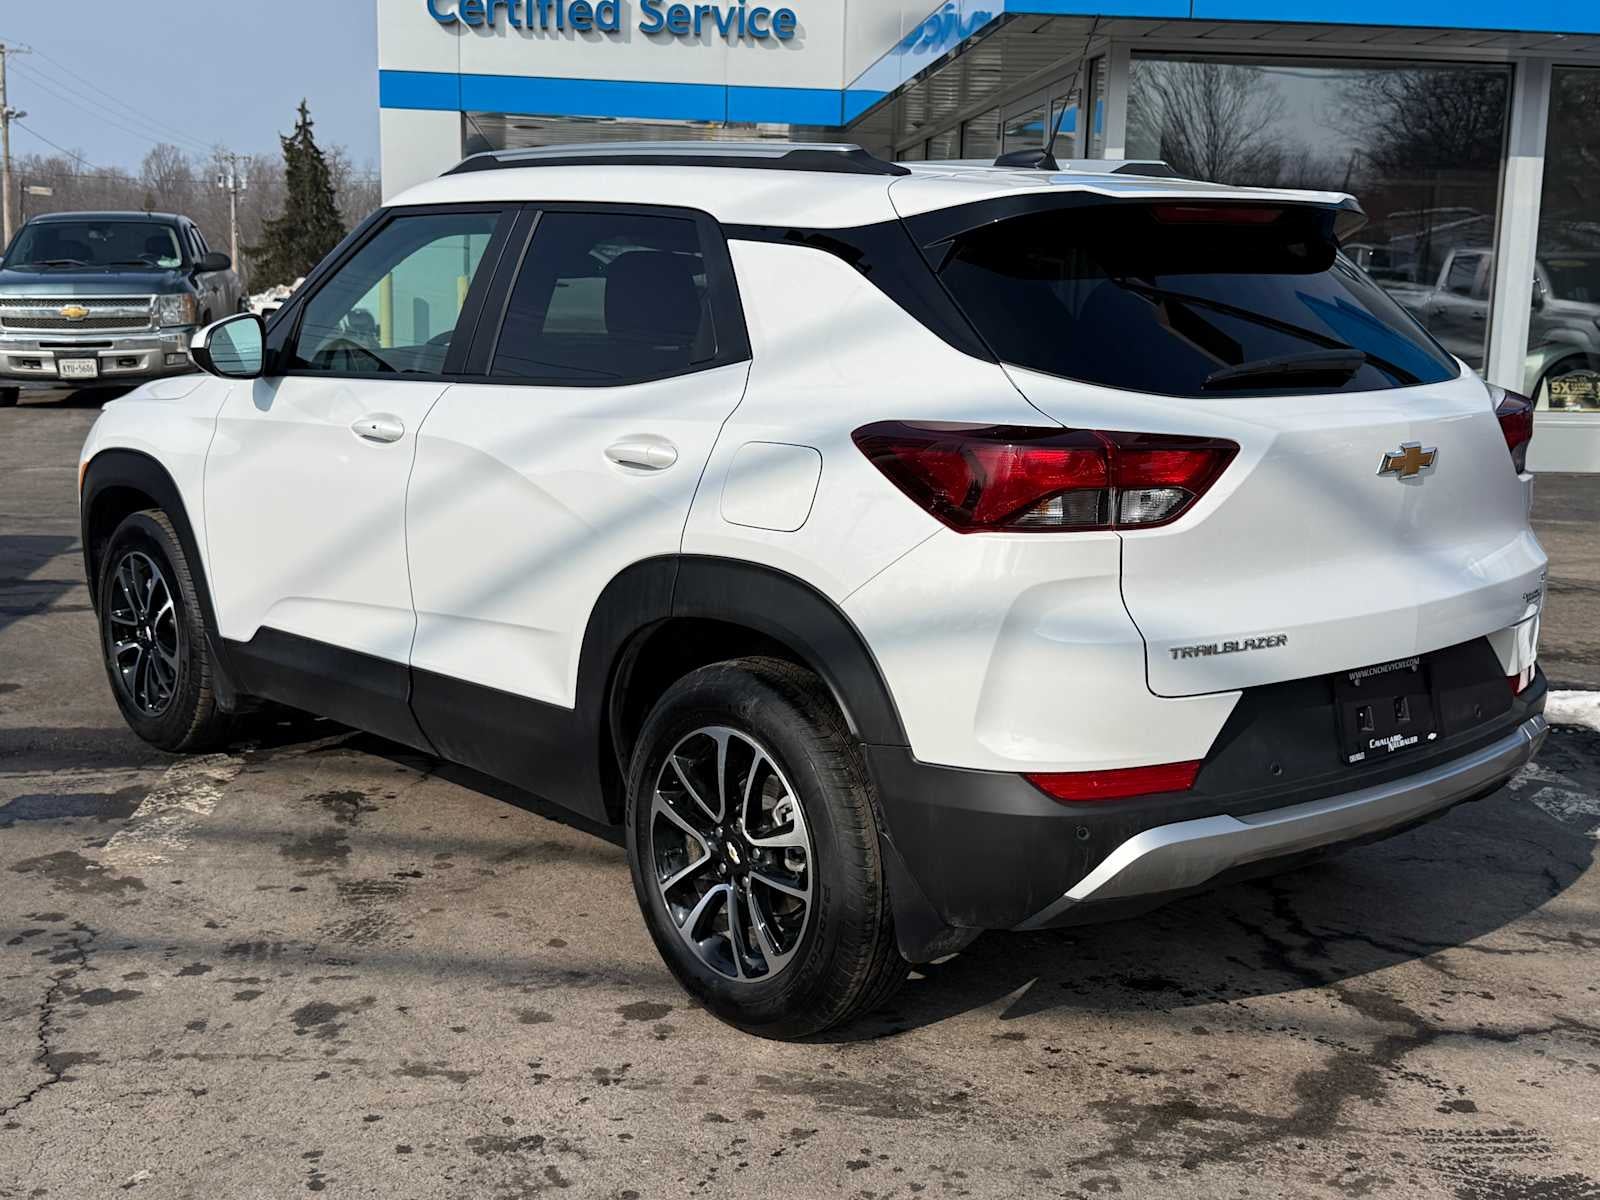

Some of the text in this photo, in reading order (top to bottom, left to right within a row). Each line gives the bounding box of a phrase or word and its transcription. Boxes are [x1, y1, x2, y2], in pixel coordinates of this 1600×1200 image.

[427, 0, 798, 39] Certified Service
[1169, 634, 1289, 660] TRAILBLAZER
